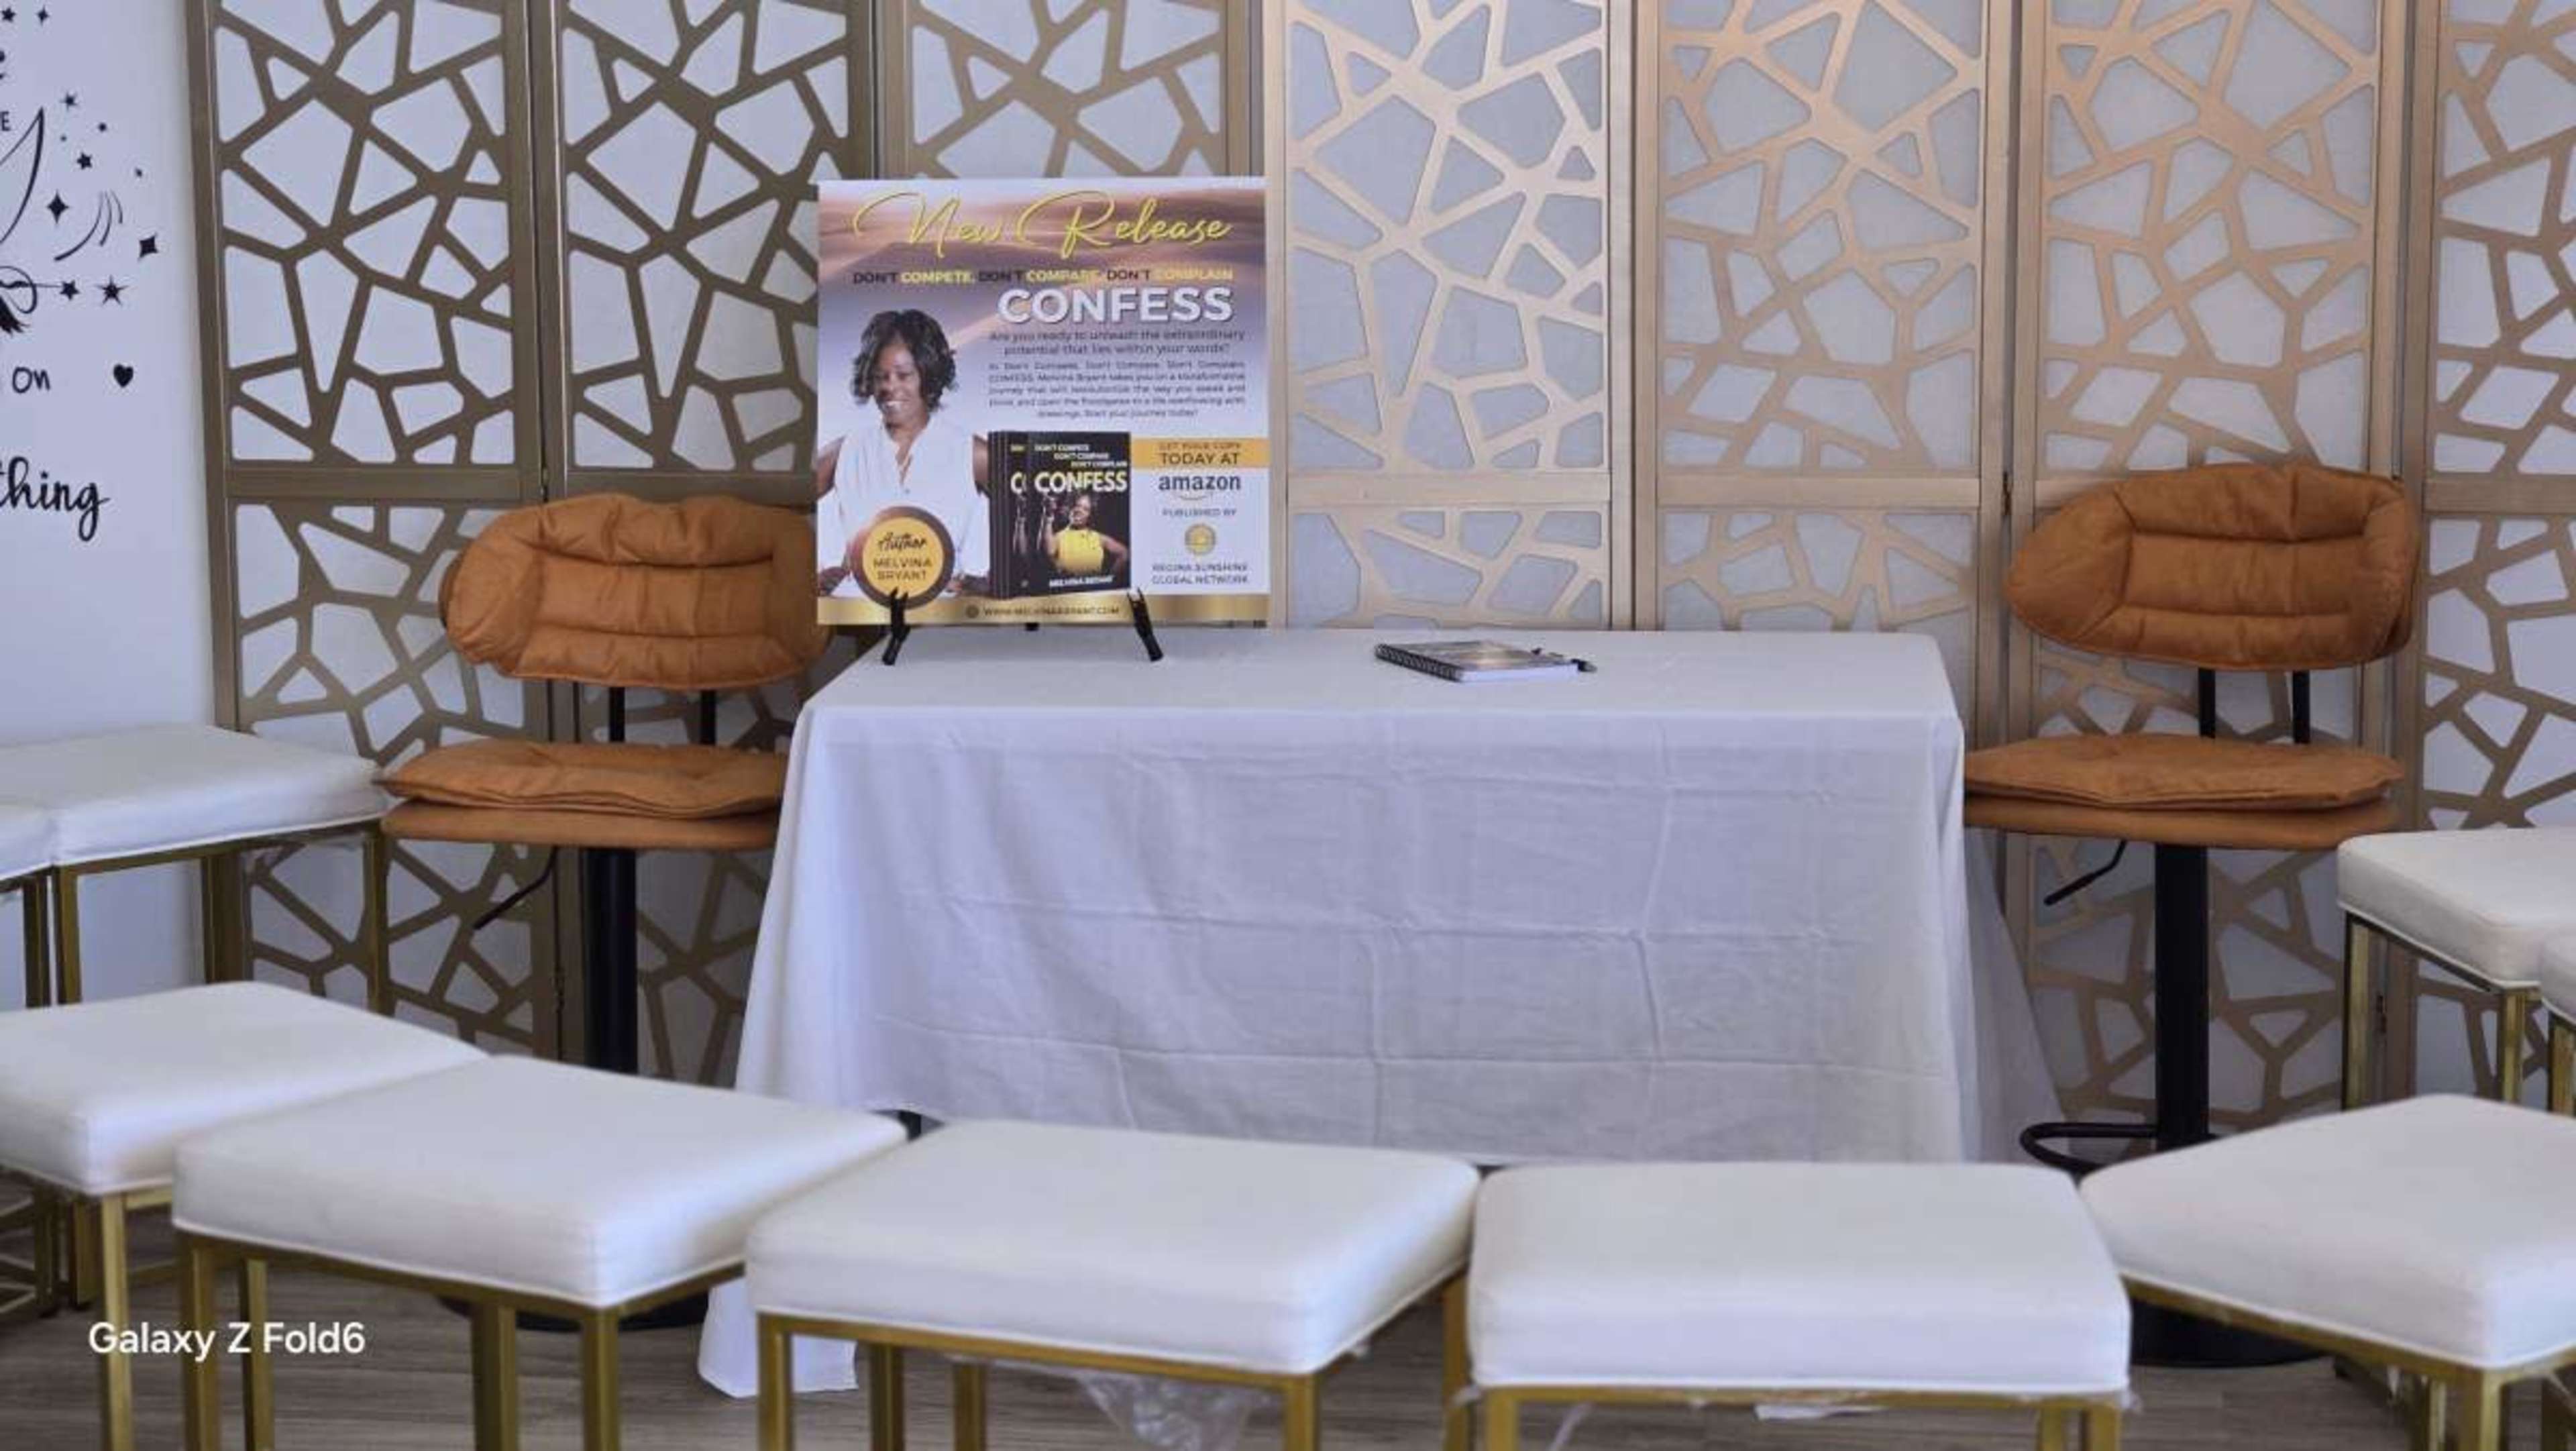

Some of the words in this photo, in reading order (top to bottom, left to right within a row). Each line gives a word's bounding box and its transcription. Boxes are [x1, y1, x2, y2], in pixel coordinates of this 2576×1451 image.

[852, 191, 1003, 259] New
[1016, 191, 1233, 260] Release
[853, 271, 898, 284] DON'T
[1107, 270, 1151, 280] DON'T
[998, 288, 1234, 324] CONFESS
[1161, 452, 1216, 464] TODAY
[1219, 452, 1240, 464] AT
[1034, 471, 1128, 493] CONFESS
[1158, 474, 1242, 491] amazon
[873, 557, 932, 568] MELVINA
[877, 571, 926, 581] BRYANT
